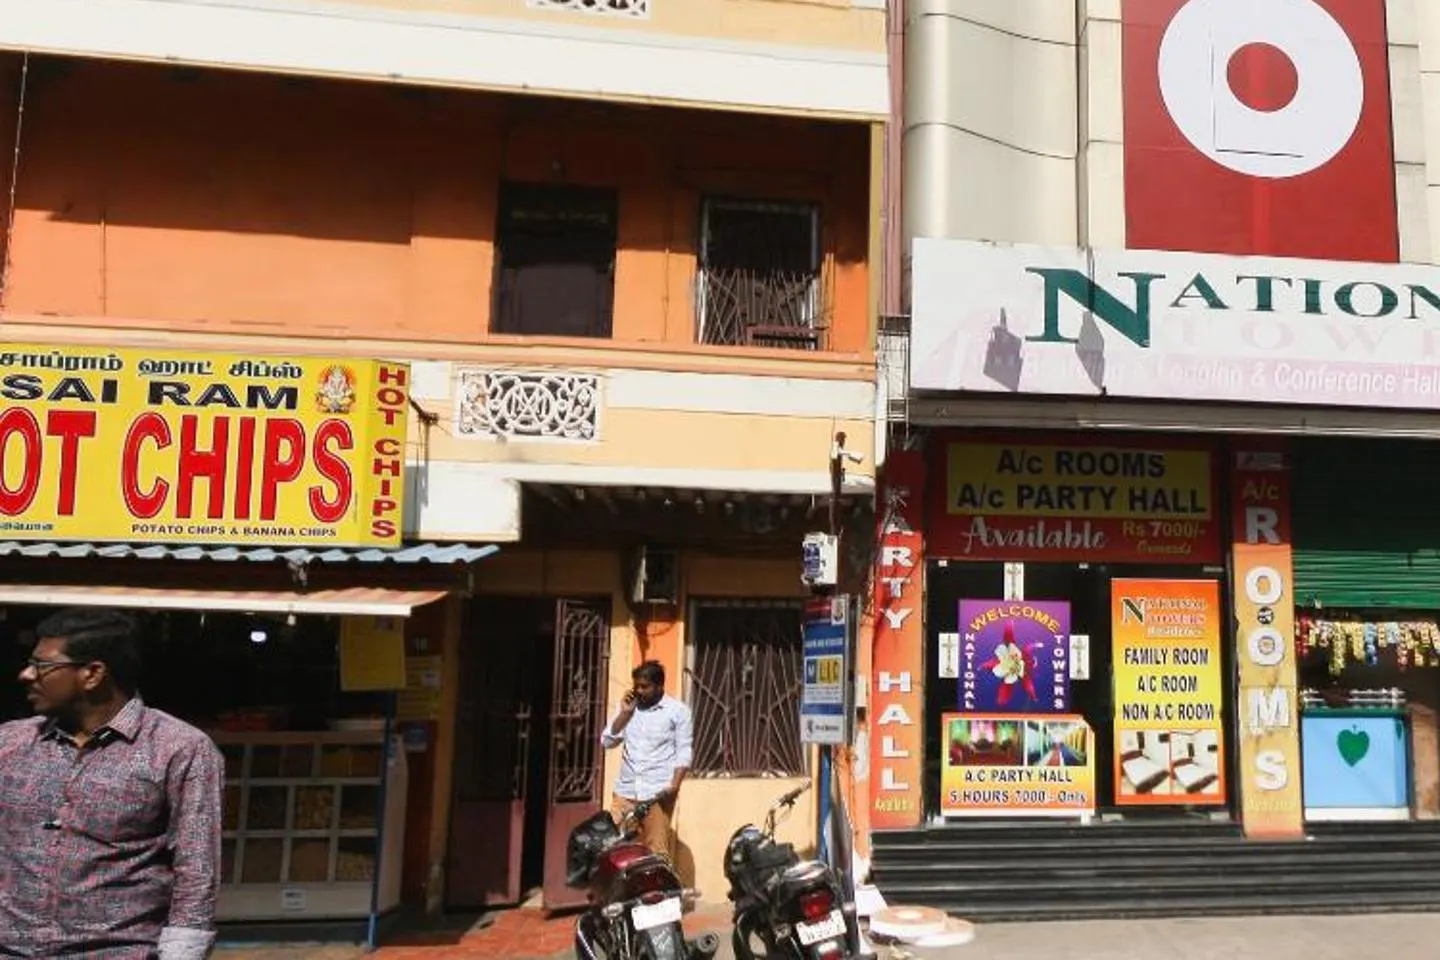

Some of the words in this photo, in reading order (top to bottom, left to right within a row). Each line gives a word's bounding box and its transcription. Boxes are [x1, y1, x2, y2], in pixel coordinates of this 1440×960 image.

[2, 374, 118, 403] SAI
[149, 381, 299, 410] RAM
[1273, 362, 1396, 394] Conference
[379, 367, 406, 426] HOT
[121, 411, 354, 524] CHIPS
[1055, 451, 1166, 478] ROOMS
[371, 438, 402, 539] CHIPS
[1017, 484, 1117, 512] PARTY
[1129, 488, 1207, 514] HALL
[132, 524, 184, 535] POTATO
[188, 525, 225, 535] CHIPS
[230, 526, 239, 536] &
[243, 526, 295, 537] BANANA
[299, 527, 337, 537] CHIPS
[961, 515, 1108, 554] Available
[969, 605, 1061, 633] WELCOME
[1125, 648, 1168, 665] FAMILY
[1173, 648, 1209, 665] ROOM
[1244, 506, 1292, 791] ROOMS
[963, 633, 976, 710] NATIONAL
[1052, 634, 1067, 710] TOWERS
[1162, 676, 1198, 693] ROOM
[1123, 703, 1149, 720] NON
[1178, 703, 1215, 720] ROOM
[877, 671, 914, 791] HALL
[991, 769, 1033, 783] PARTY
[1038, 769, 1072, 783] HALL
[963, 790, 1010, 803] HOURS
